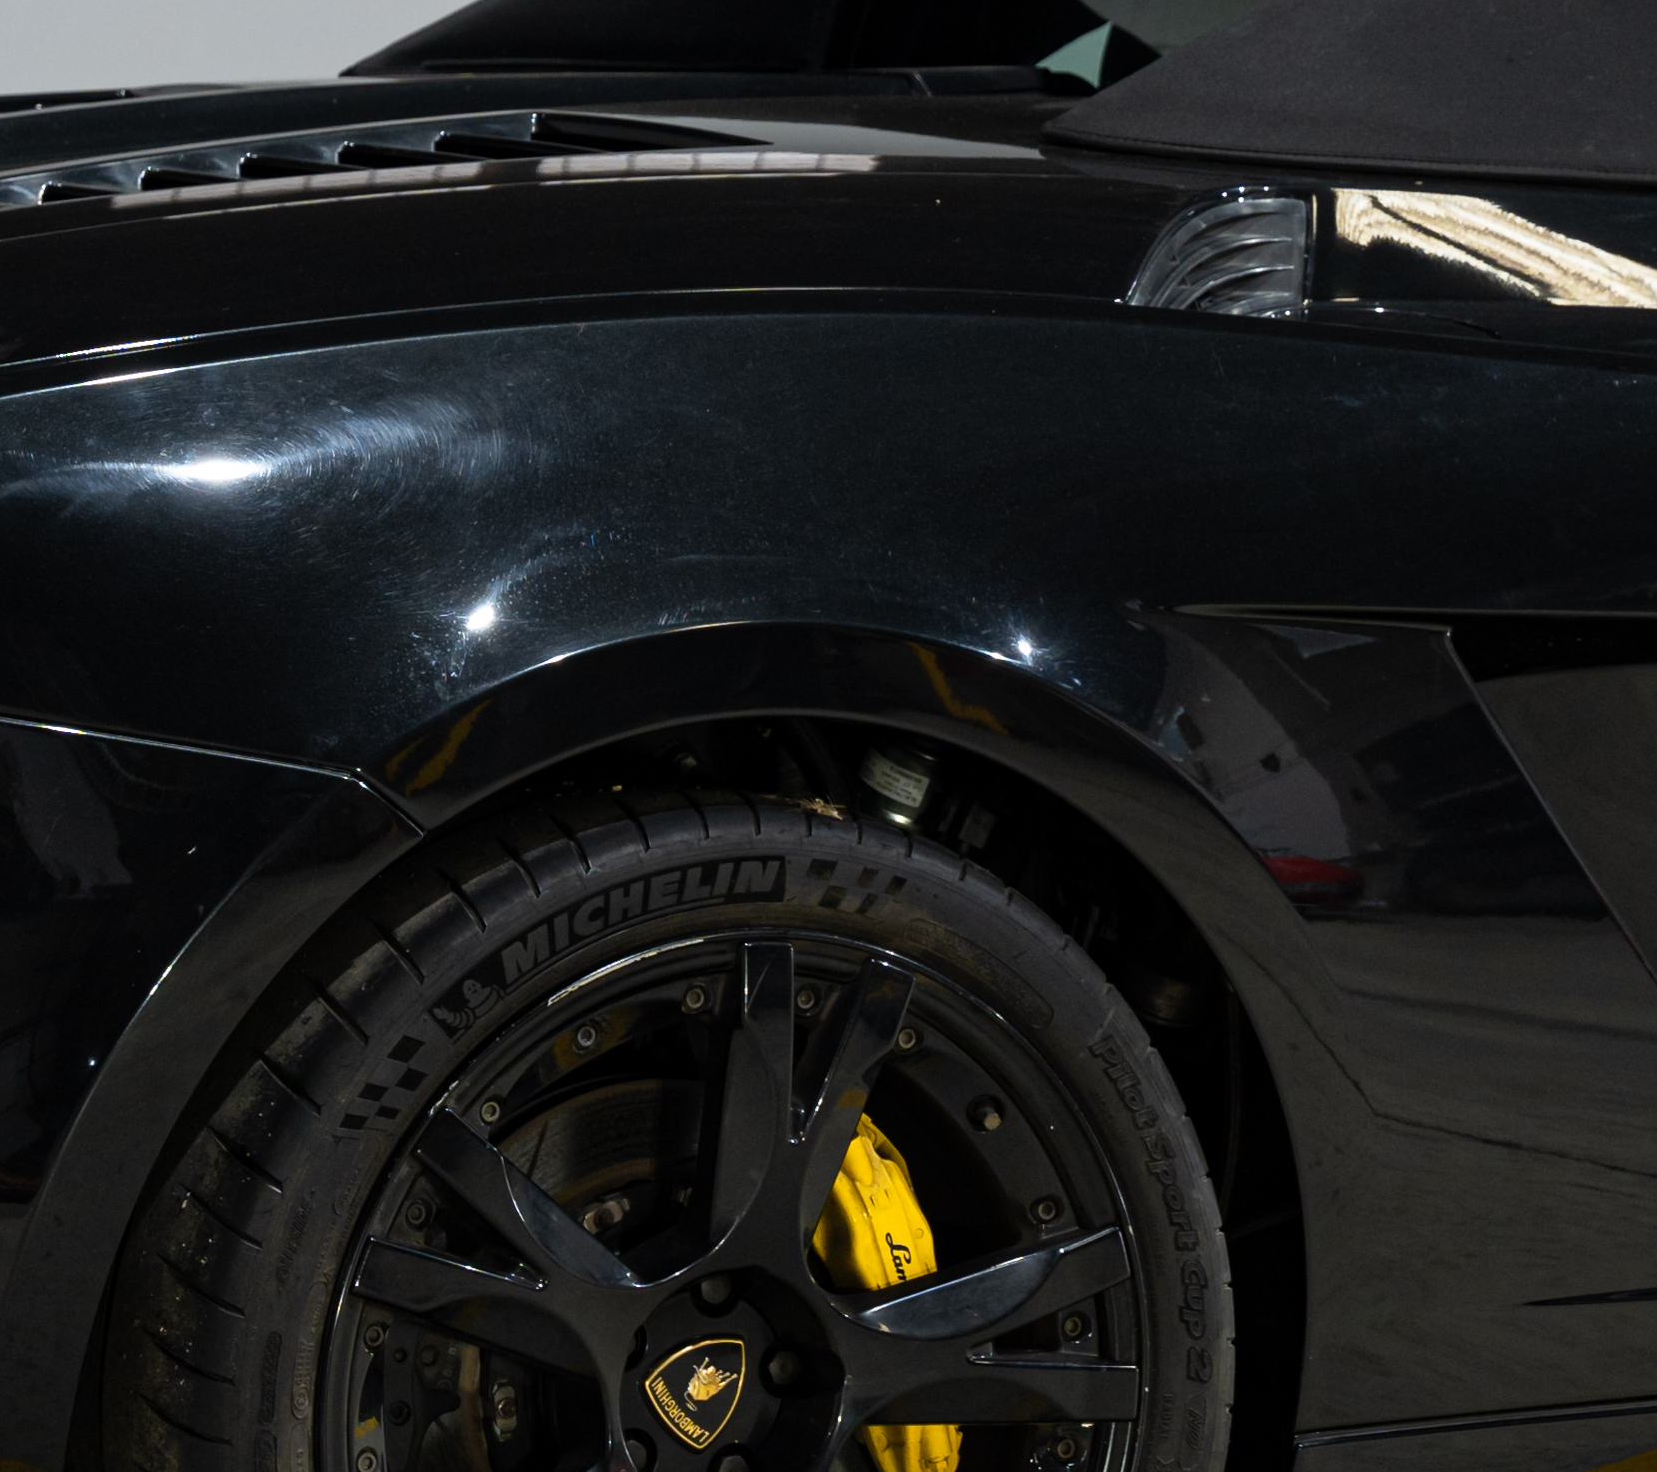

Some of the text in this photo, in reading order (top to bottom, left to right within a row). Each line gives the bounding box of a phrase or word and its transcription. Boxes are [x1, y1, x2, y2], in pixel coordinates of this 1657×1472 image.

[501, 857, 779, 984] MICHELIN
[1088, 1035, 1213, 1384] Pilot Sport Cup 2
[651, 1376, 710, 1443] LAMBORGHINI
